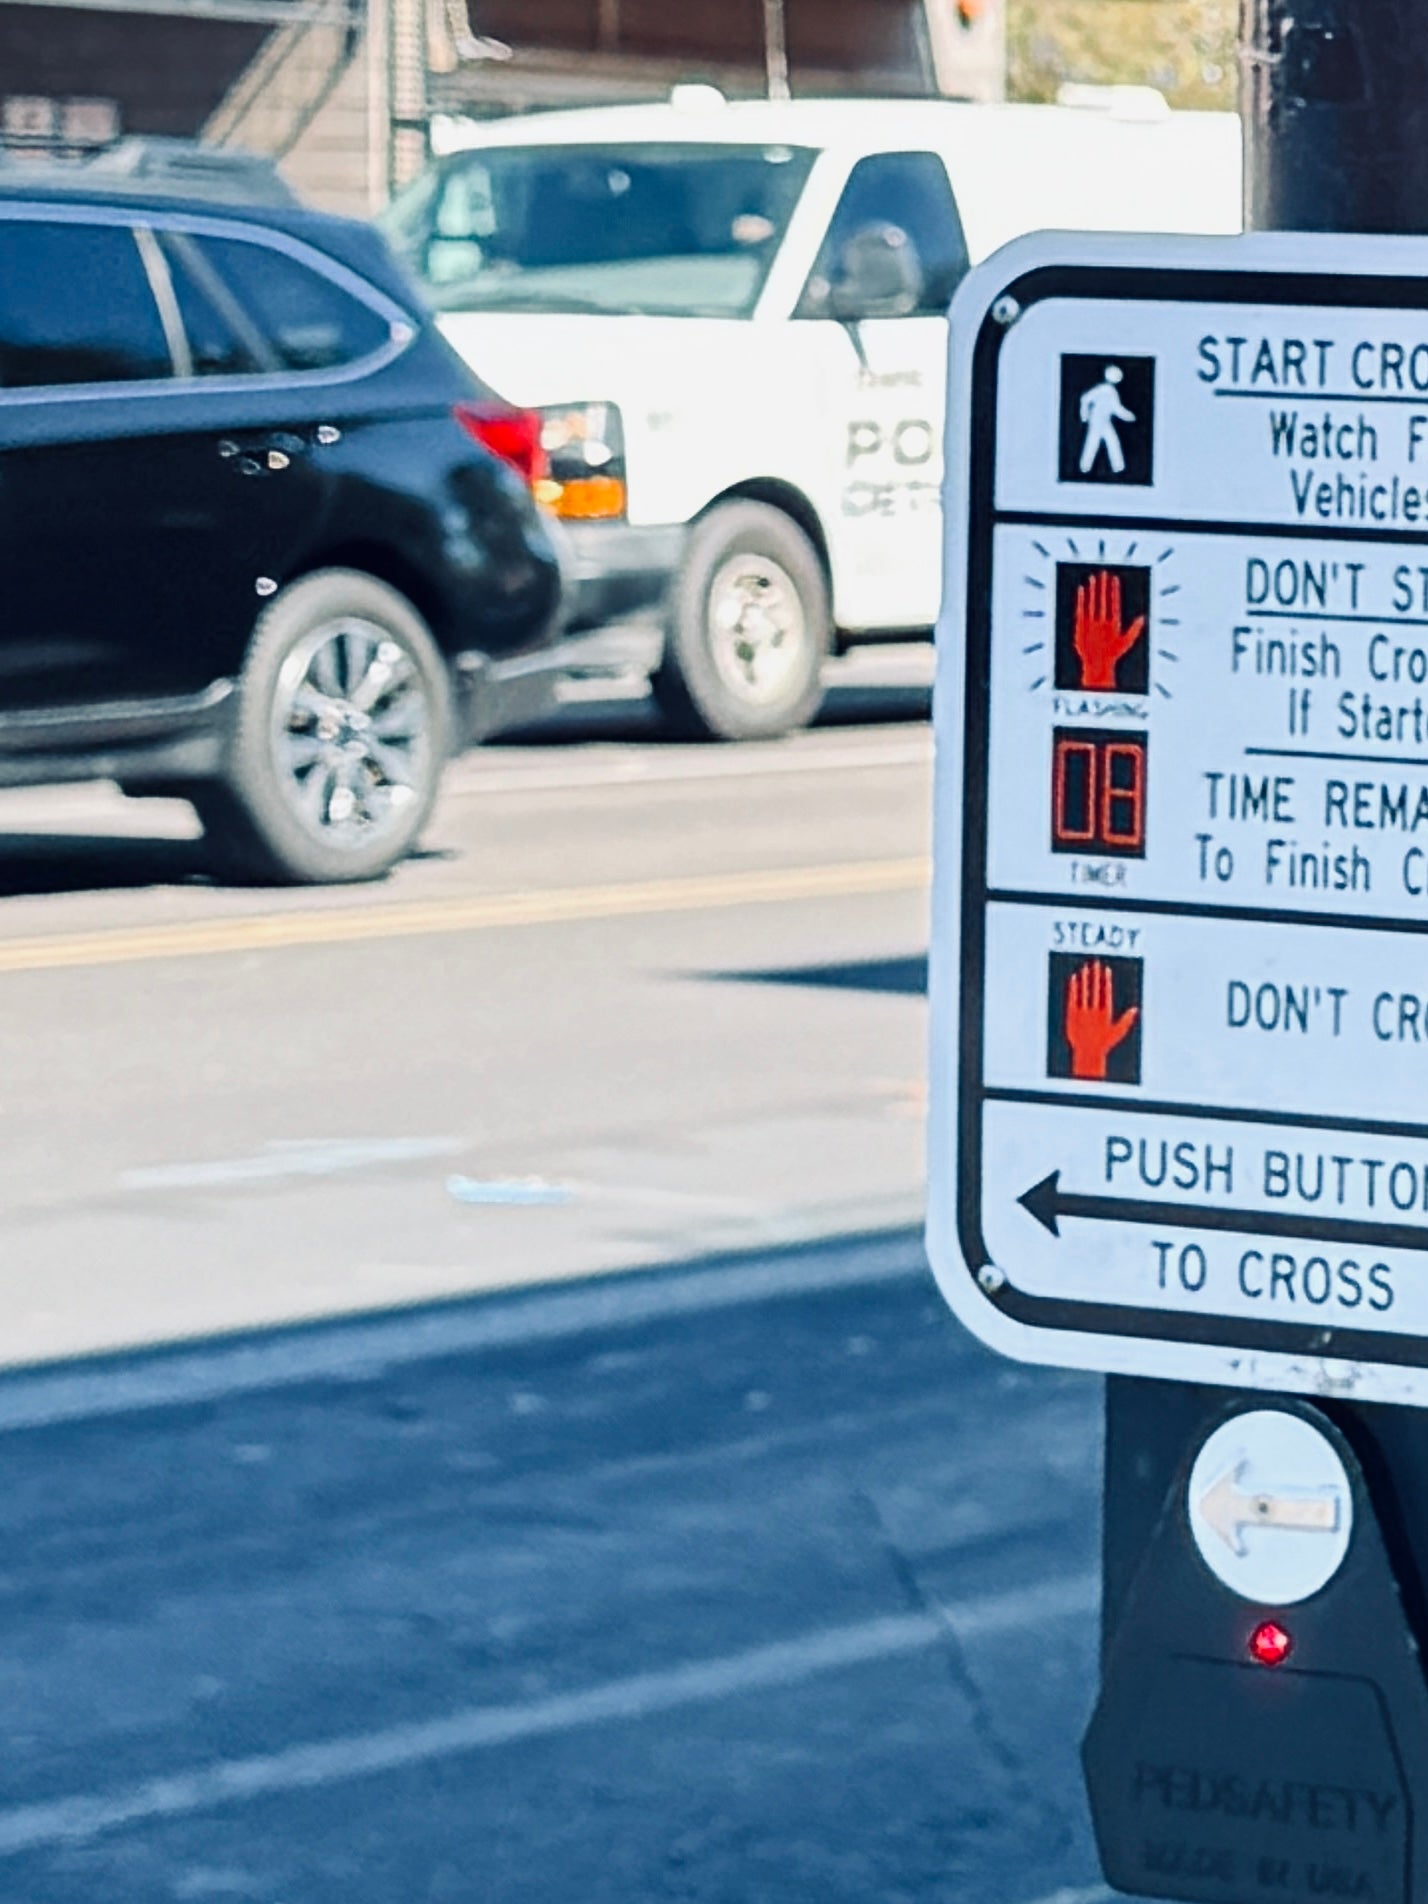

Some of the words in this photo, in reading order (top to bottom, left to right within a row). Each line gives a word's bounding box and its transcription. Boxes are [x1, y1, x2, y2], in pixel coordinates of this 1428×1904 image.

[1197, 335, 1334, 386] START
[1269, 410, 1377, 461] Watch
[1246, 557, 1366, 609] DON'T
[1231, 625, 1341, 678] Finish
[1288, 687, 1311, 736] If
[1057, 740, 1143, 845] 08
[1204, 772, 1295, 823] TIME
[1070, 861, 1128, 887] TIMER
[1195, 833, 1234, 882] To
[1266, 839, 1371, 892] Finish
[1052, 922, 1141, 948] STEADY
[1227, 980, 1348, 1036] DON'T
[1105, 1135, 1234, 1194] PUSH
[1151, 1240, 1207, 1291] TO
[1238, 1249, 1395, 1311] CROSS
[1132, 1760, 1398, 1836] PEDSAFETY
